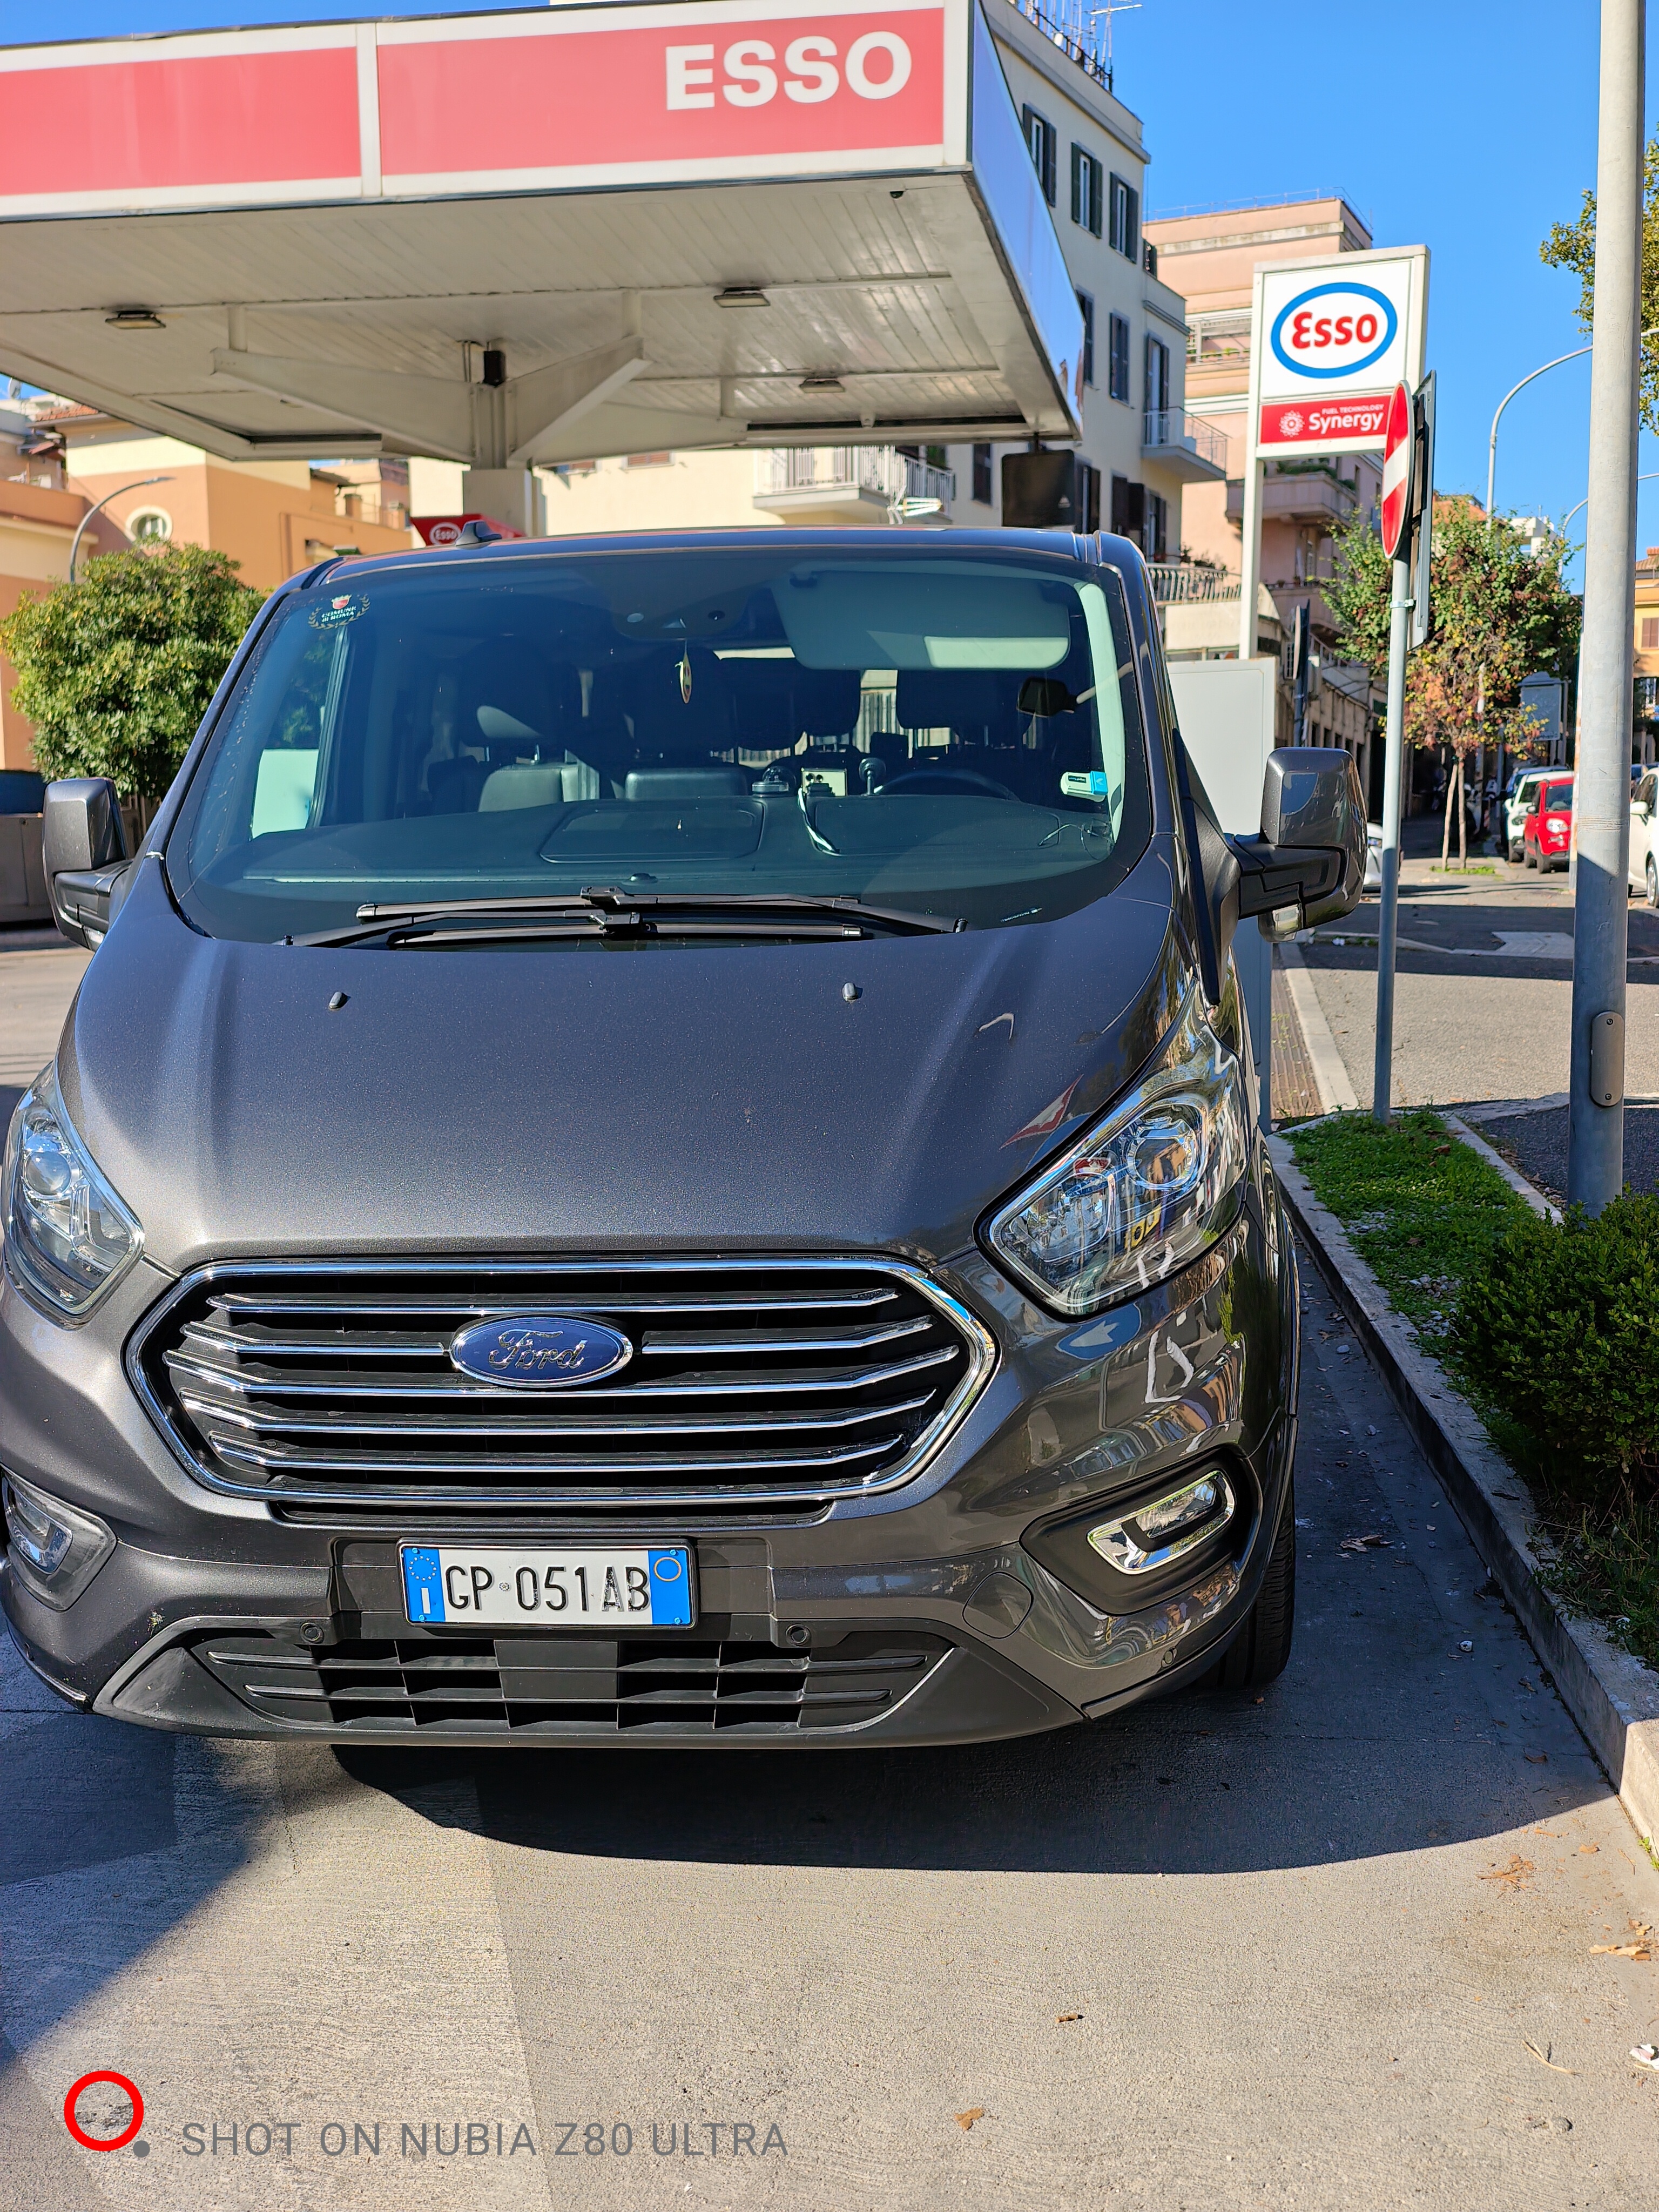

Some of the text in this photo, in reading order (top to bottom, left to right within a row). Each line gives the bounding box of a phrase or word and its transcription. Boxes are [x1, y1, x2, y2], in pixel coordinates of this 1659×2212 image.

[666, 31, 912, 110] ESSO
[1292, 311, 1378, 349] Esso
[1308, 412, 1384, 435] Synergy
[1339, 404, 1384, 413] TECHNOLOGY
[321, 606, 356, 618] COMUNE
[330, 612, 354, 621] ROMA
[488, 1328, 588, 1370] Ford
[444, 1565, 493, 1611] GP
